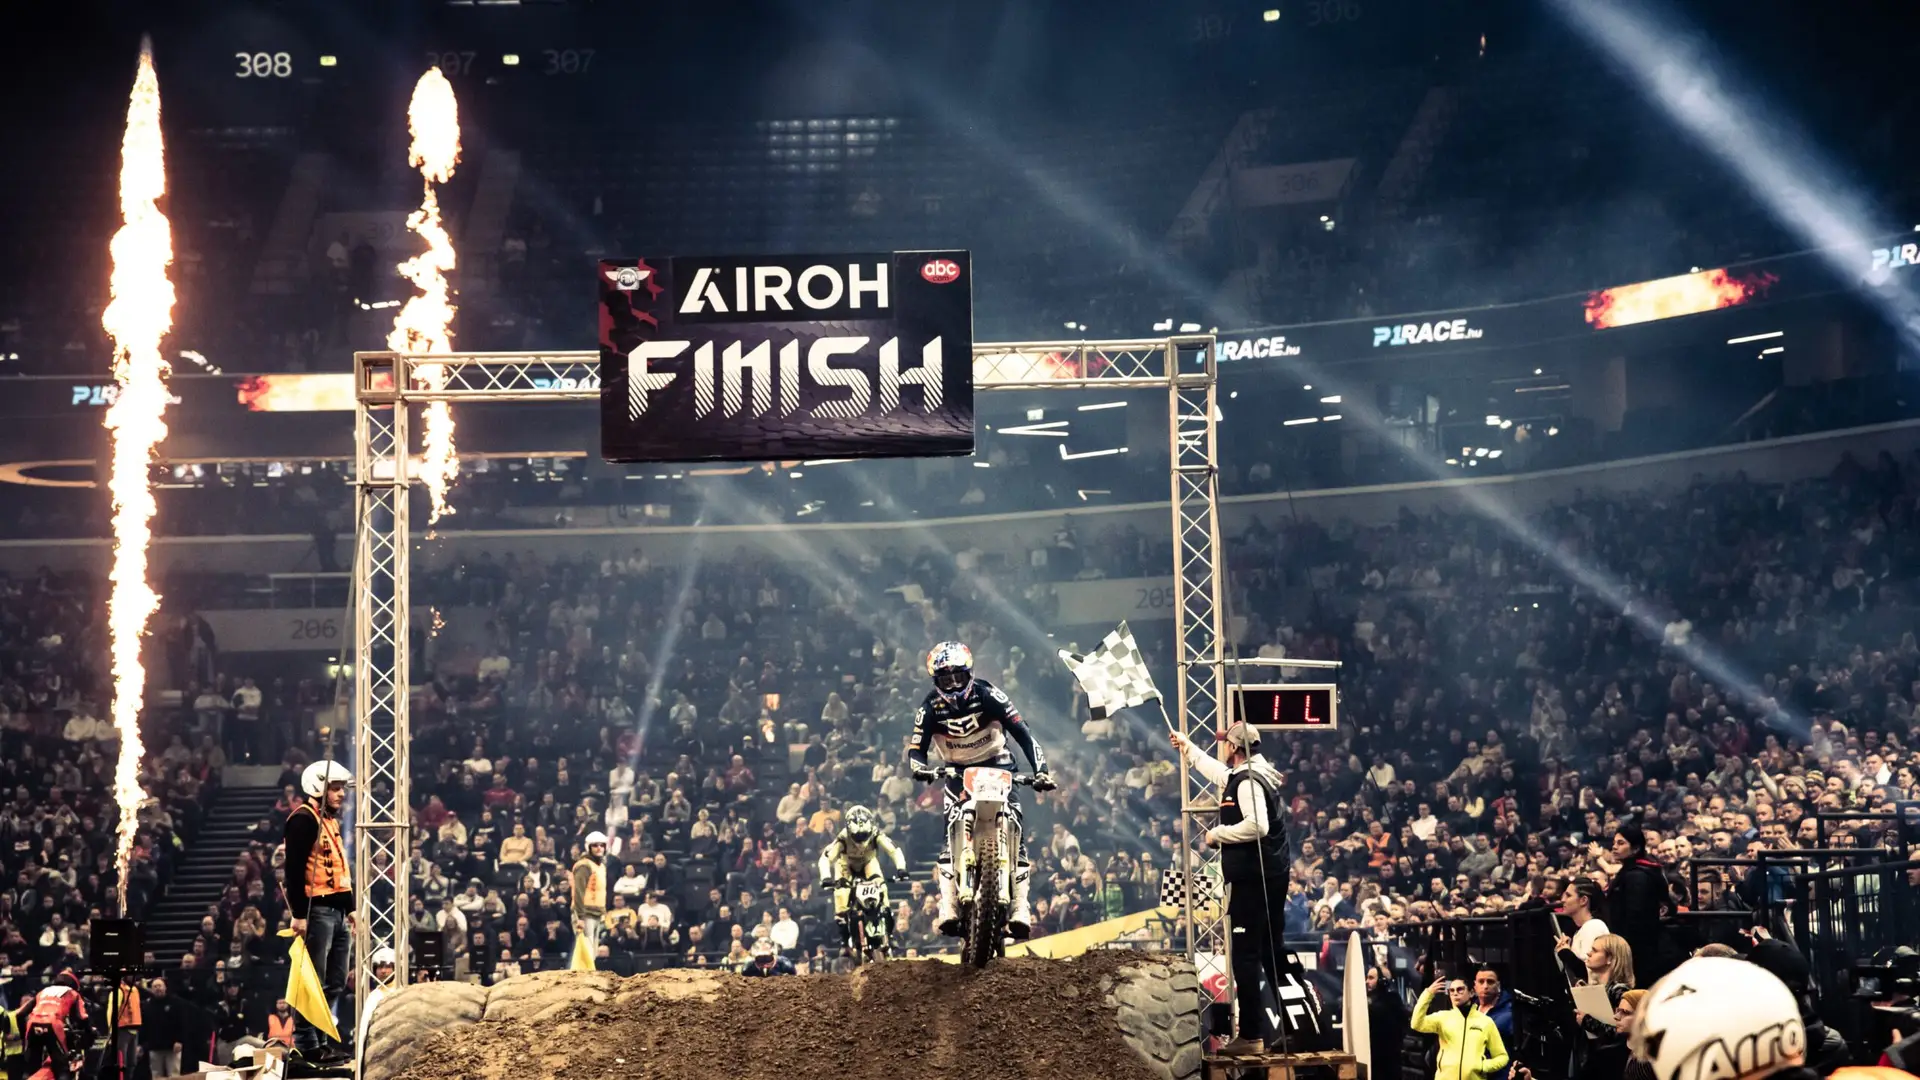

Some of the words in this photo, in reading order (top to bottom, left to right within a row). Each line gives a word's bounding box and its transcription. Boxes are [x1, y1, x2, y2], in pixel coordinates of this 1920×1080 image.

[234, 51, 293, 78] 308
[541, 49, 597, 75] 307
[924, 260, 956, 276] abc
[679, 262, 889, 313] AIROH
[1373, 320, 1483, 347] P1RACE.hu
[627, 335, 943, 422] FINISH
[1135, 587, 1175, 609] 205
[291, 618, 337, 640] 206
[1304, 694, 1320, 722] L
